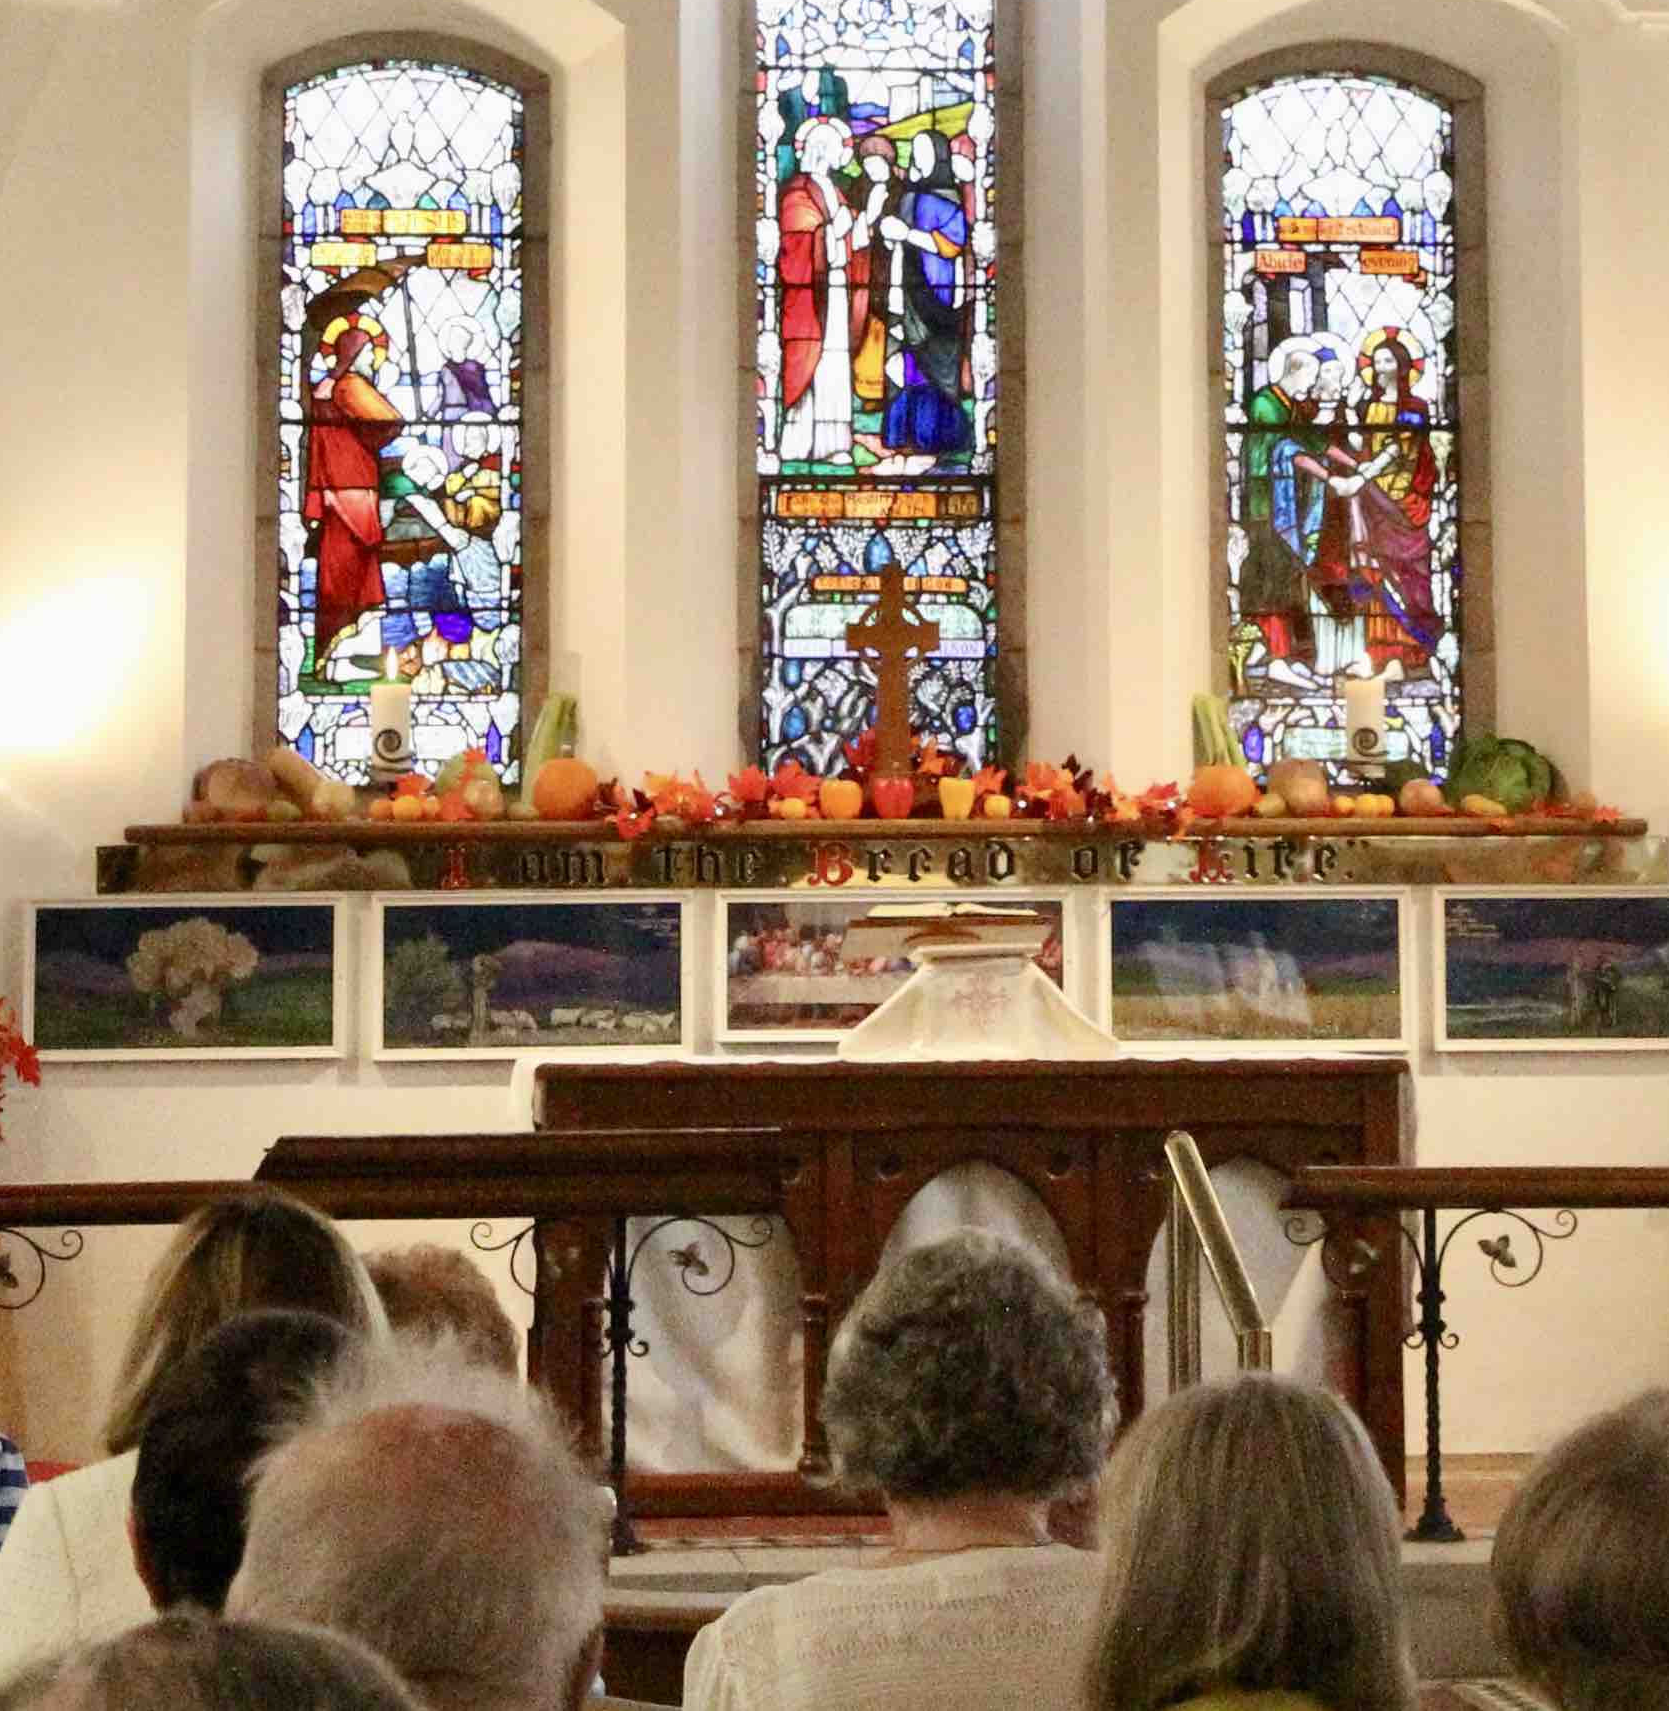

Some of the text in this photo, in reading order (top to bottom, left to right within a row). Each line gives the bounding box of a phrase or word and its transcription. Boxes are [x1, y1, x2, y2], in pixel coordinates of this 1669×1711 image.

[521, 849, 608, 884] am
[654, 841, 759, 884] the
[808, 840, 1015, 887] Bread
[1074, 841, 1144, 882] of
